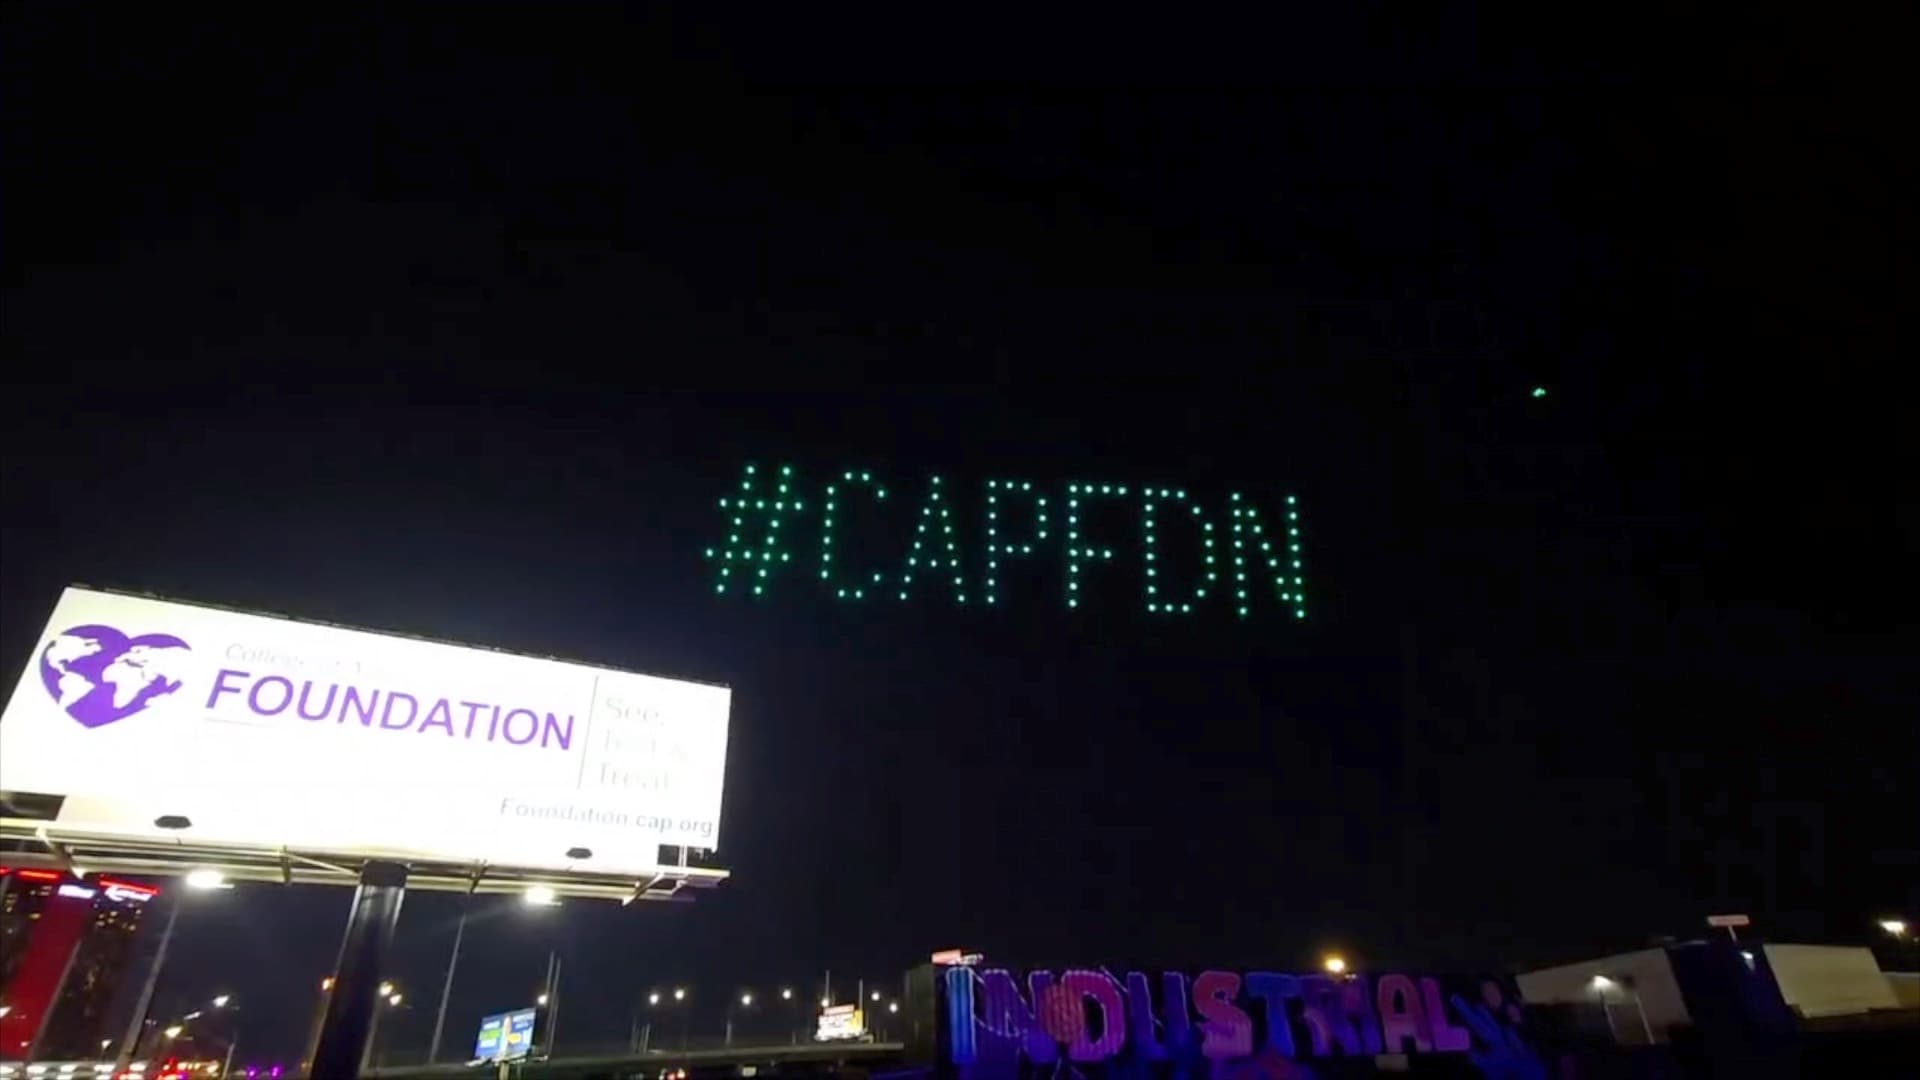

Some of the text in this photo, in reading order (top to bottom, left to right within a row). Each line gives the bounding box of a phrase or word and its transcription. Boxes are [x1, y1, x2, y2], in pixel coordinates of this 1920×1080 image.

[705, 464, 1307, 618] #CAPFDN
[205, 668, 576, 751] FOUNDATION
[946, 967, 1470, 1063] INDUSTRIAL
